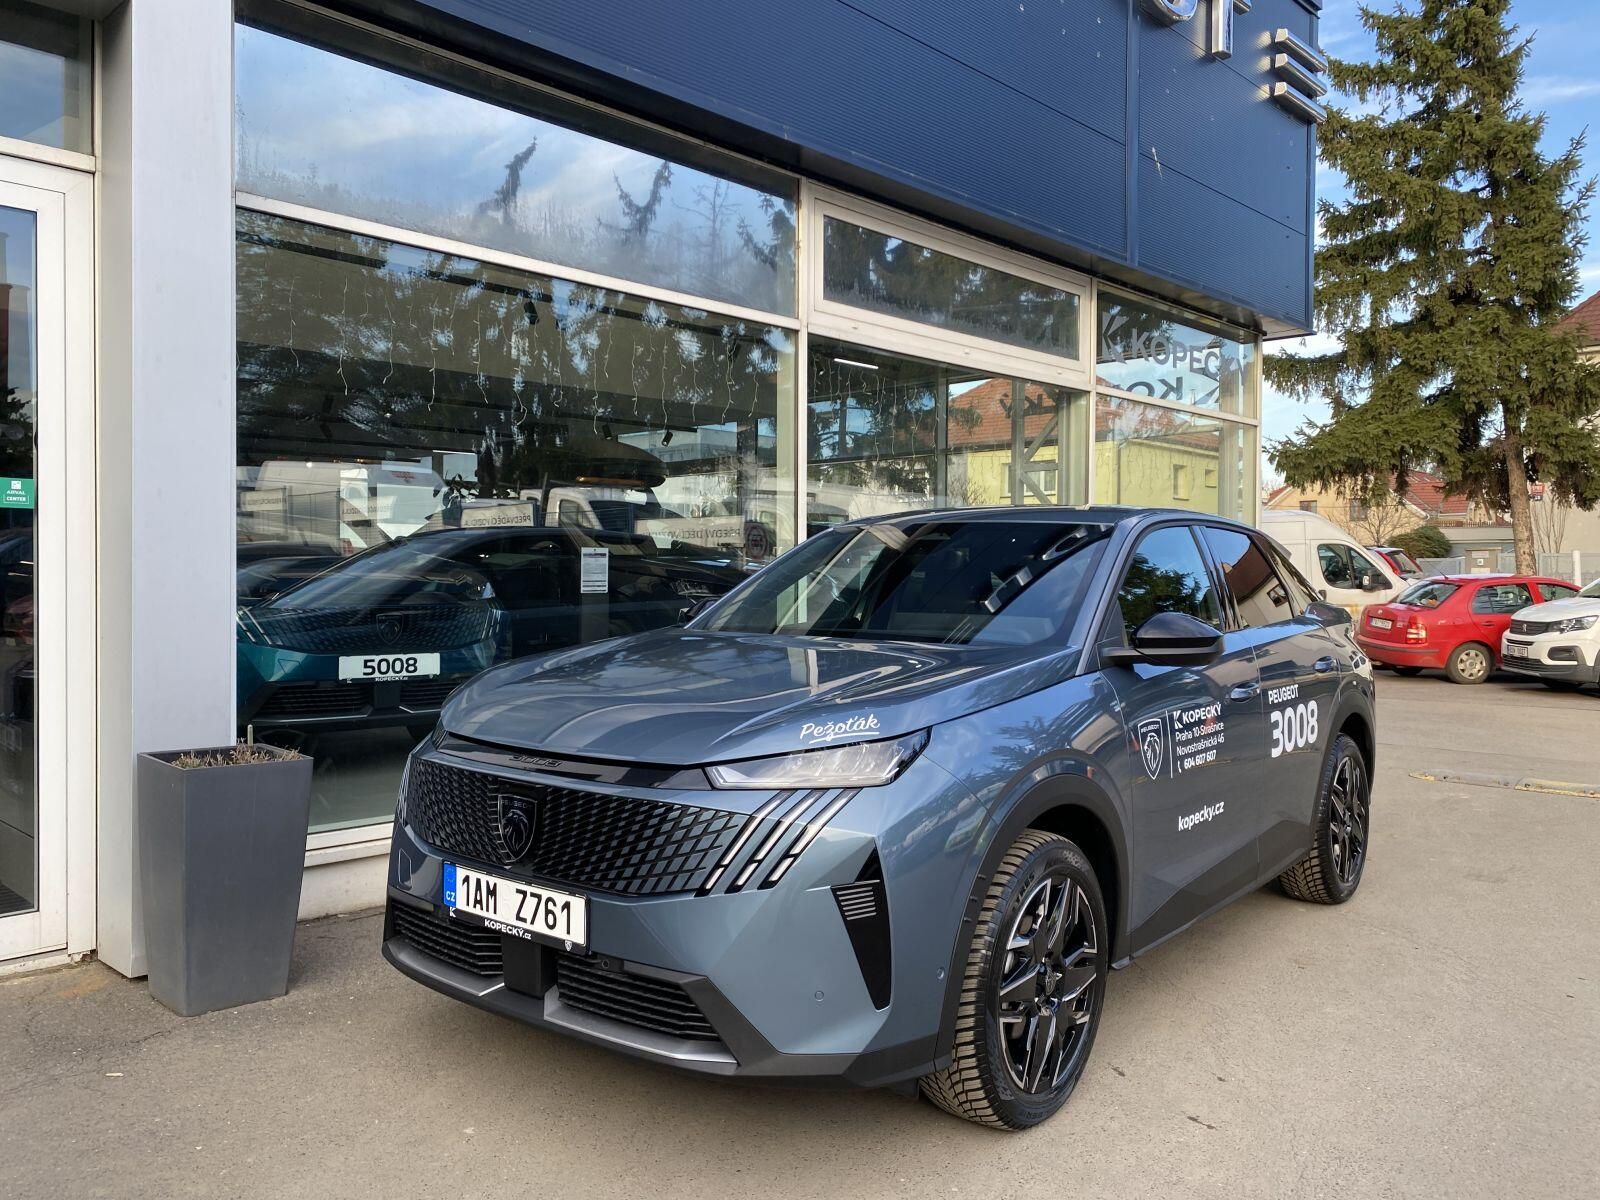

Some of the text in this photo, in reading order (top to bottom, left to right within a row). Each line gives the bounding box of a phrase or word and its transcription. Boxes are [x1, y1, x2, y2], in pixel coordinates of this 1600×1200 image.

[362, 657, 418, 676] 5008
[1268, 684, 1299, 704] PEUGEOT
[1182, 702, 1222, 724] KOPECKÝ
[800, 713, 880, 742] Pežoťák
[1175, 729, 1192, 742] Praha
[1270, 700, 1318, 758] 3008
[1178, 801, 1225, 831] kopecky.cz
[445, 890, 456, 902] CZ
[462, 874, 572, 935] 1AM Z761
[484, 918, 532, 940] KOPECKÝ.cz
